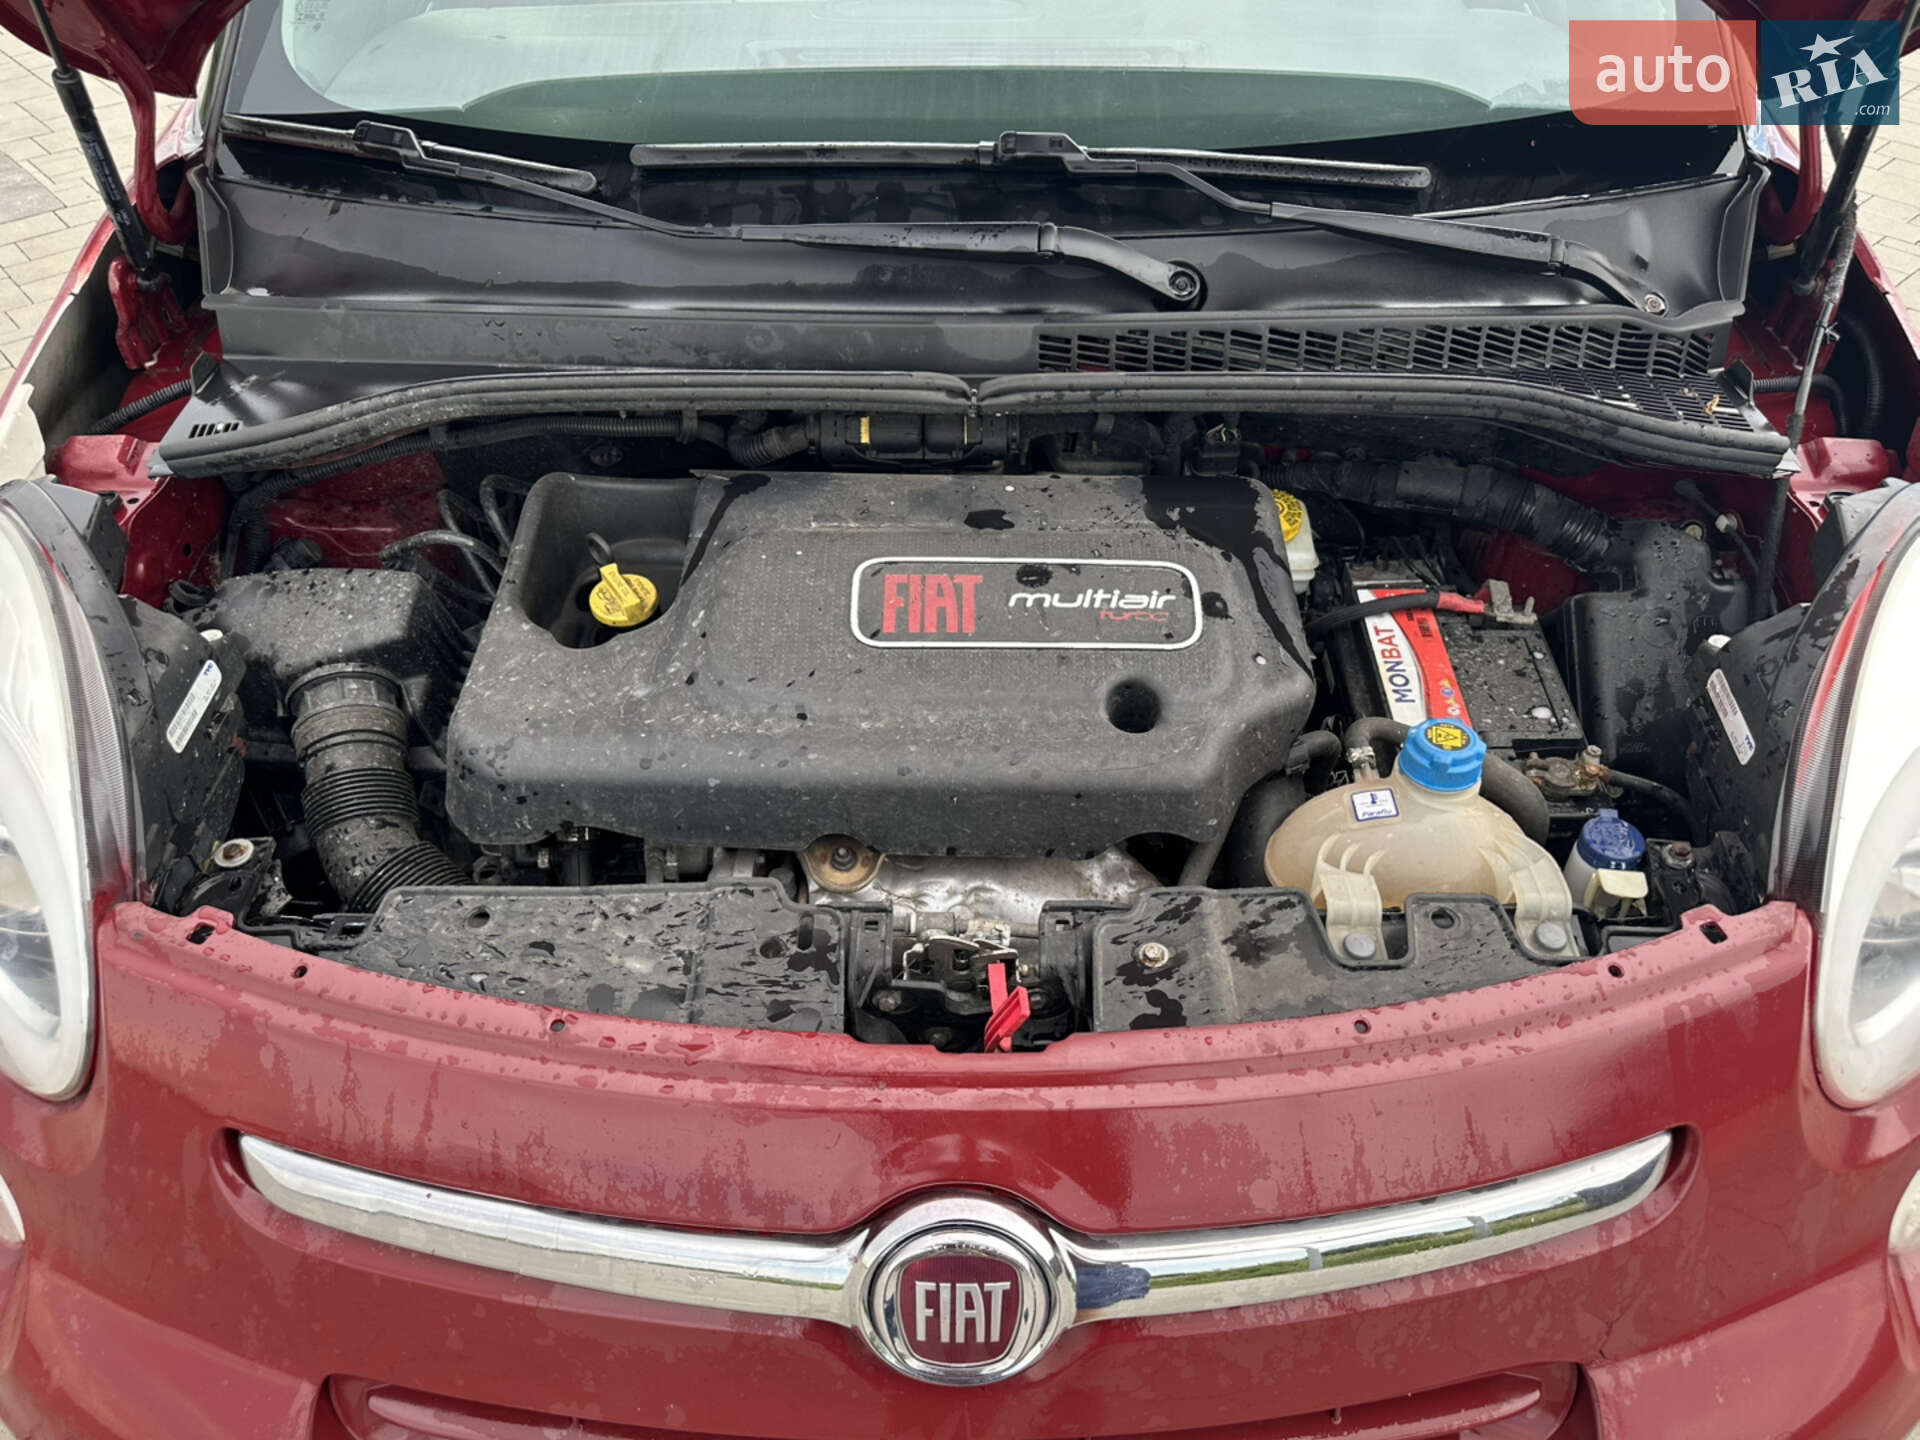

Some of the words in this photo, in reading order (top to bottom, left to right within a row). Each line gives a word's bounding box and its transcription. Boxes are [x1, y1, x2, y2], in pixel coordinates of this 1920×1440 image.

[882, 575, 984, 633] FIAT
[1007, 589, 1176, 609] multiair
[1099, 610, 1170, 622] turbo
[1373, 625, 1416, 704] MONBAT
[915, 1280, 1012, 1343] FIAT
